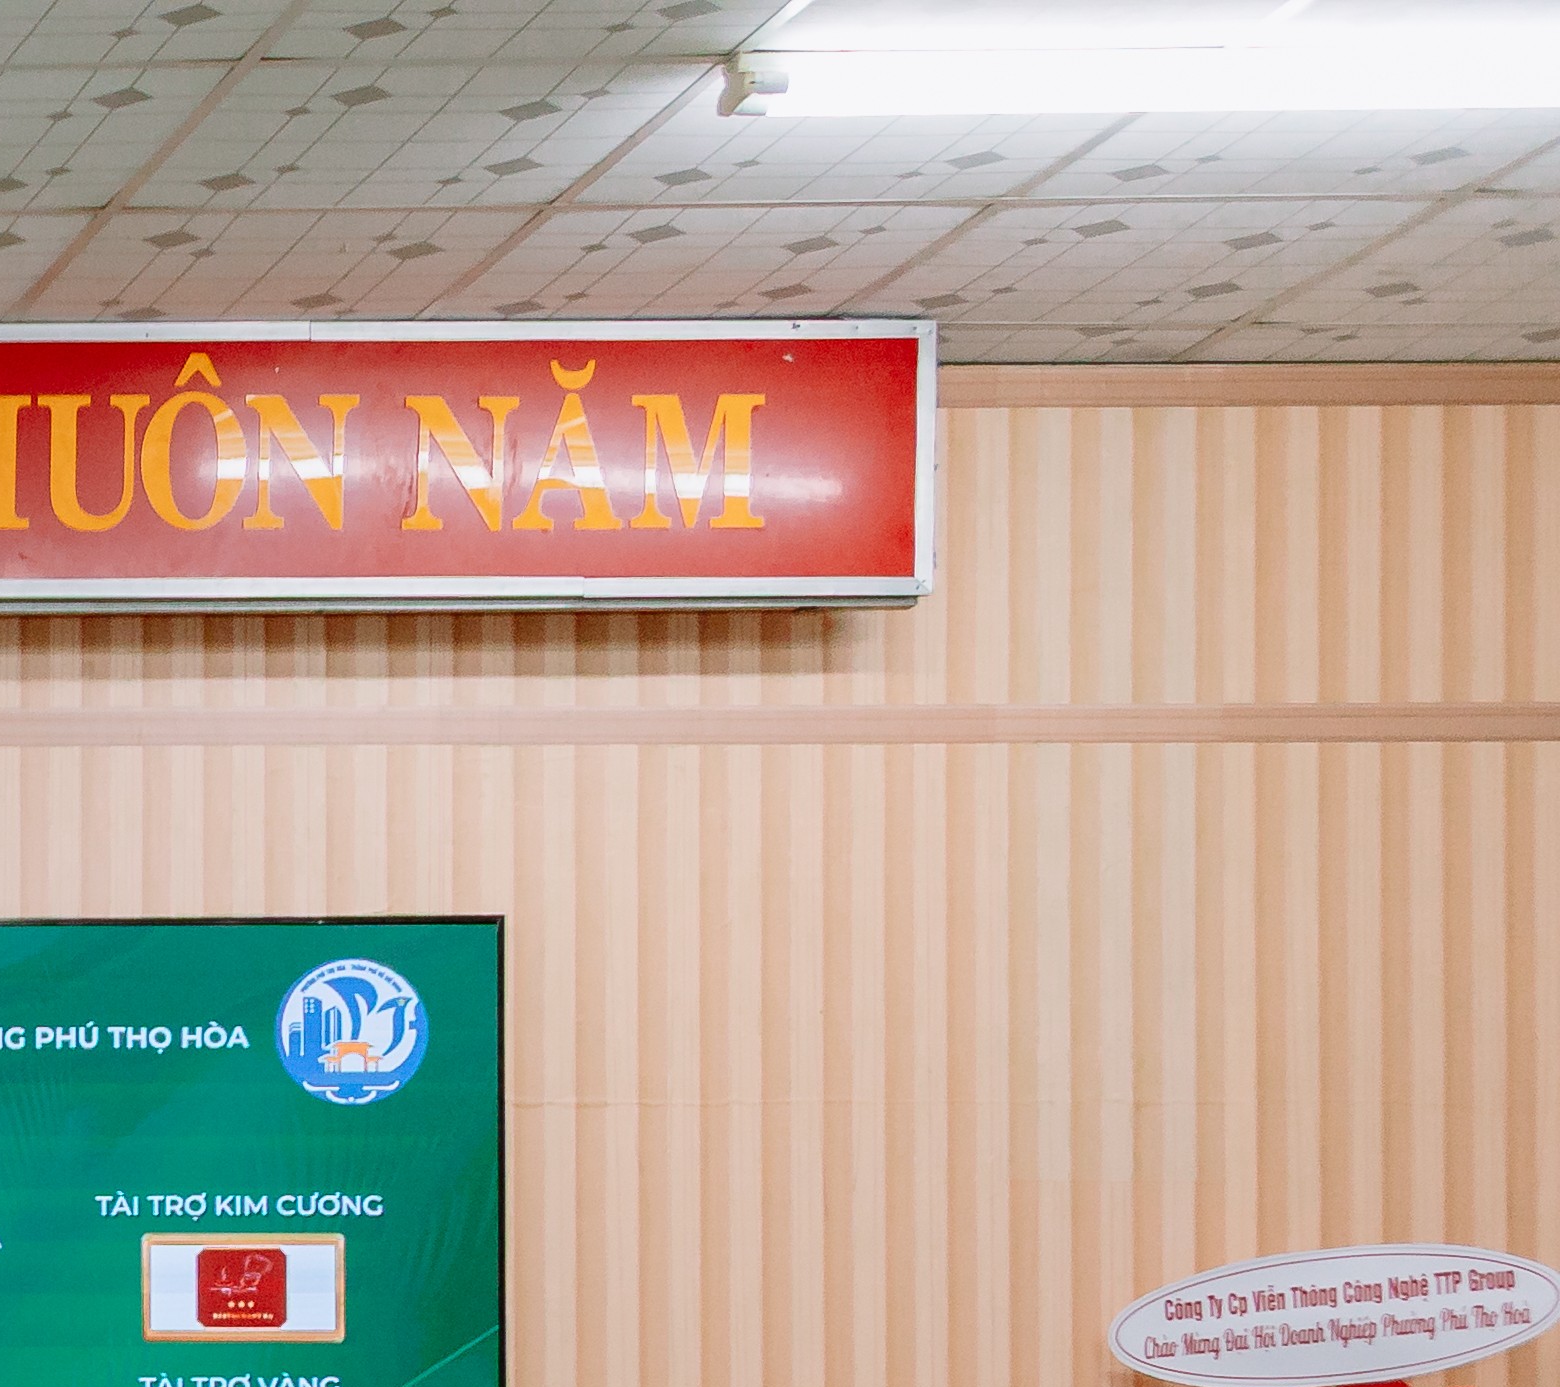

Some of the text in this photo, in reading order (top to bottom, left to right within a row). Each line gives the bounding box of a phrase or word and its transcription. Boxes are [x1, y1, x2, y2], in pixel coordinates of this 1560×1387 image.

[402, 358, 769, 533] NĂM
[35, 1020, 100, 1050] PHÚ
[107, 1026, 173, 1056] THỌ
[181, 1020, 250, 1049] HÒA
[94, 1190, 384, 1223] TÀI TRỢ KIM CƯƠNG
